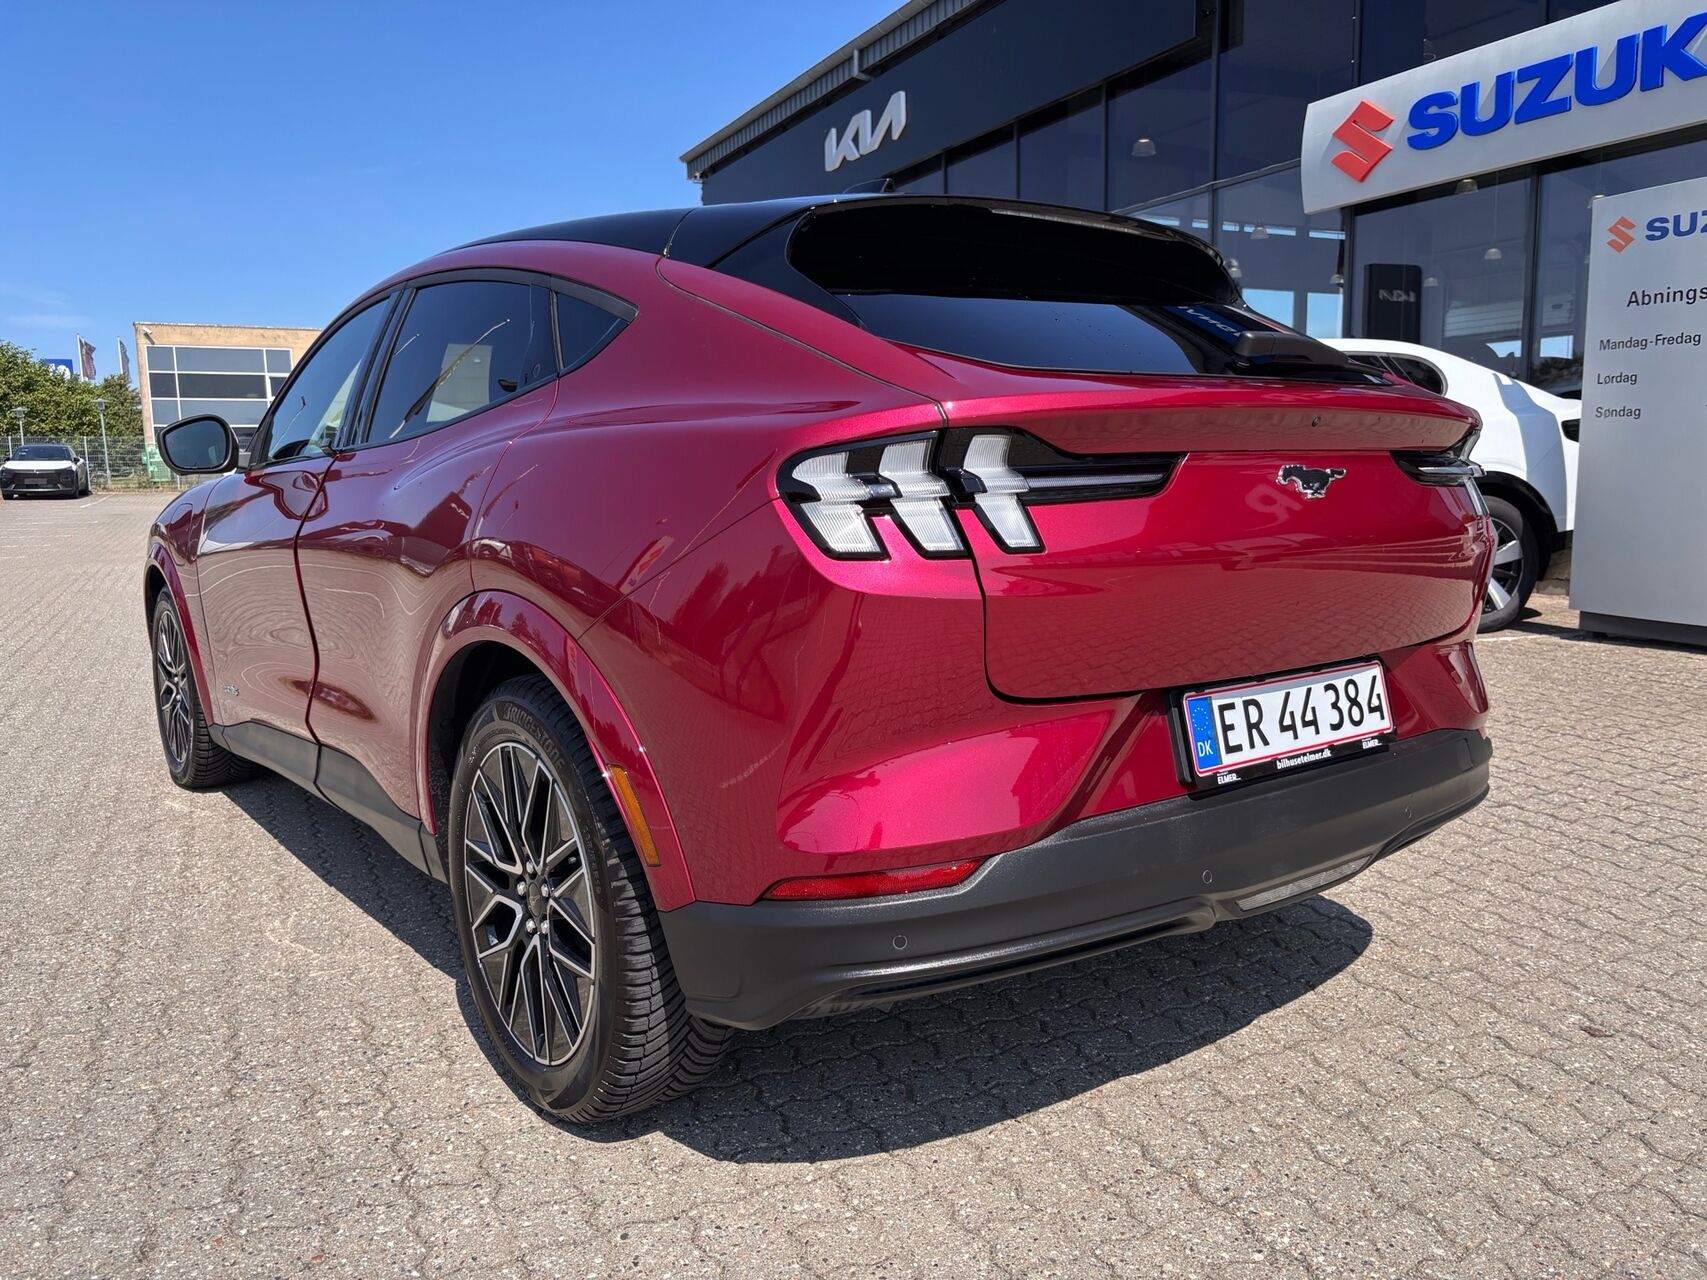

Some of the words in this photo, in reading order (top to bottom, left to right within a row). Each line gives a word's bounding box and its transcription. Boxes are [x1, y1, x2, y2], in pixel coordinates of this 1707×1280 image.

[824, 90, 906, 172] KIA
[1645, 209, 1707, 241] SU
[1597, 371, 1638, 386] Lørdag
[1595, 405, 1641, 420] Søndag
[1217, 698, 1270, 755] ER
[1278, 687, 1320, 740] 44
[1323, 675, 1385, 731] 384
[1197, 740, 1214, 757] DK
[1276, 748, 1332, 770] bilhusetelmer.dk
